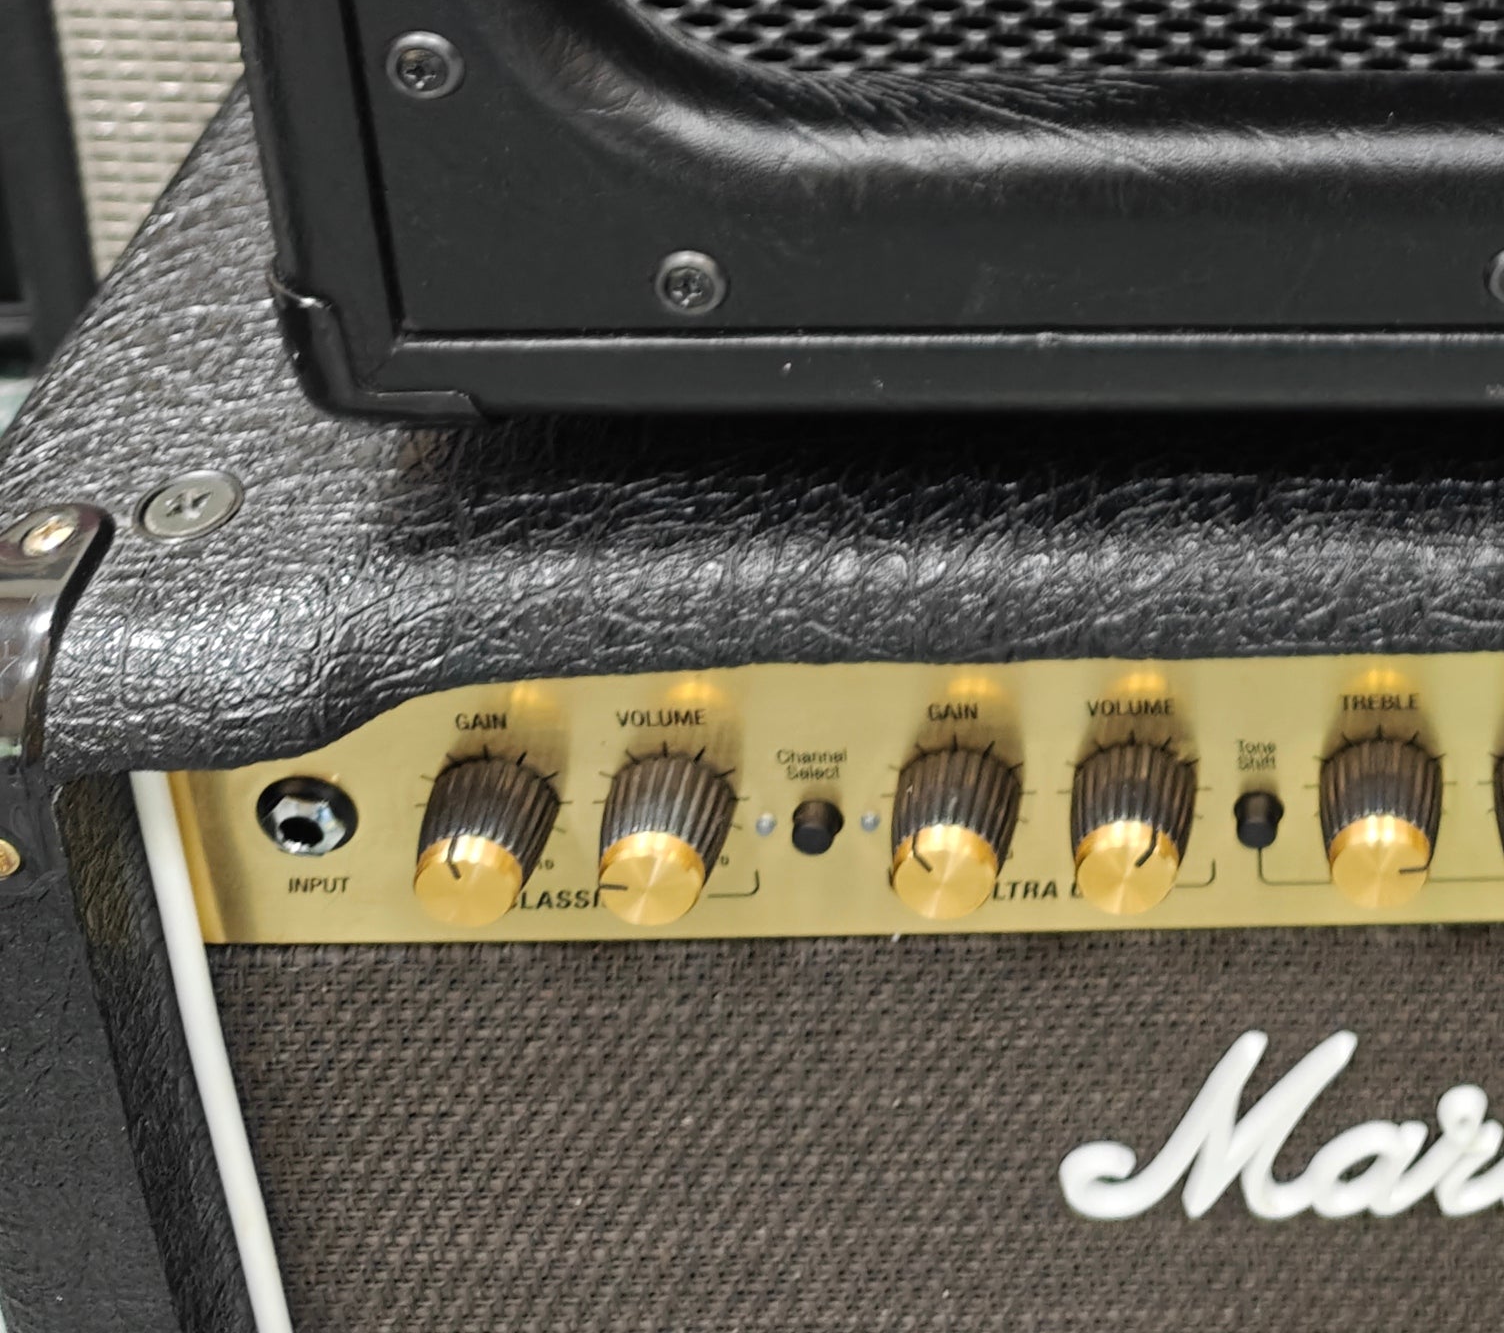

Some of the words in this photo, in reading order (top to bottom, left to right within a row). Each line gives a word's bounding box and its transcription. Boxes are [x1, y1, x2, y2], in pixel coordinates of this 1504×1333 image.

[927, 703, 979, 721] GAIN
[1087, 698, 1175, 717] VOLUME
[1340, 694, 1419, 712] TREBLE
[455, 712, 508, 731] GAIN
[616, 709, 706, 728] VOLUME
[1238, 739, 1277, 754] Tone
[775, 748, 848, 766] Channel
[1238, 754, 1277, 772] Shift
[785, 766, 841, 781] Select
[288, 876, 350, 894] INPUT
